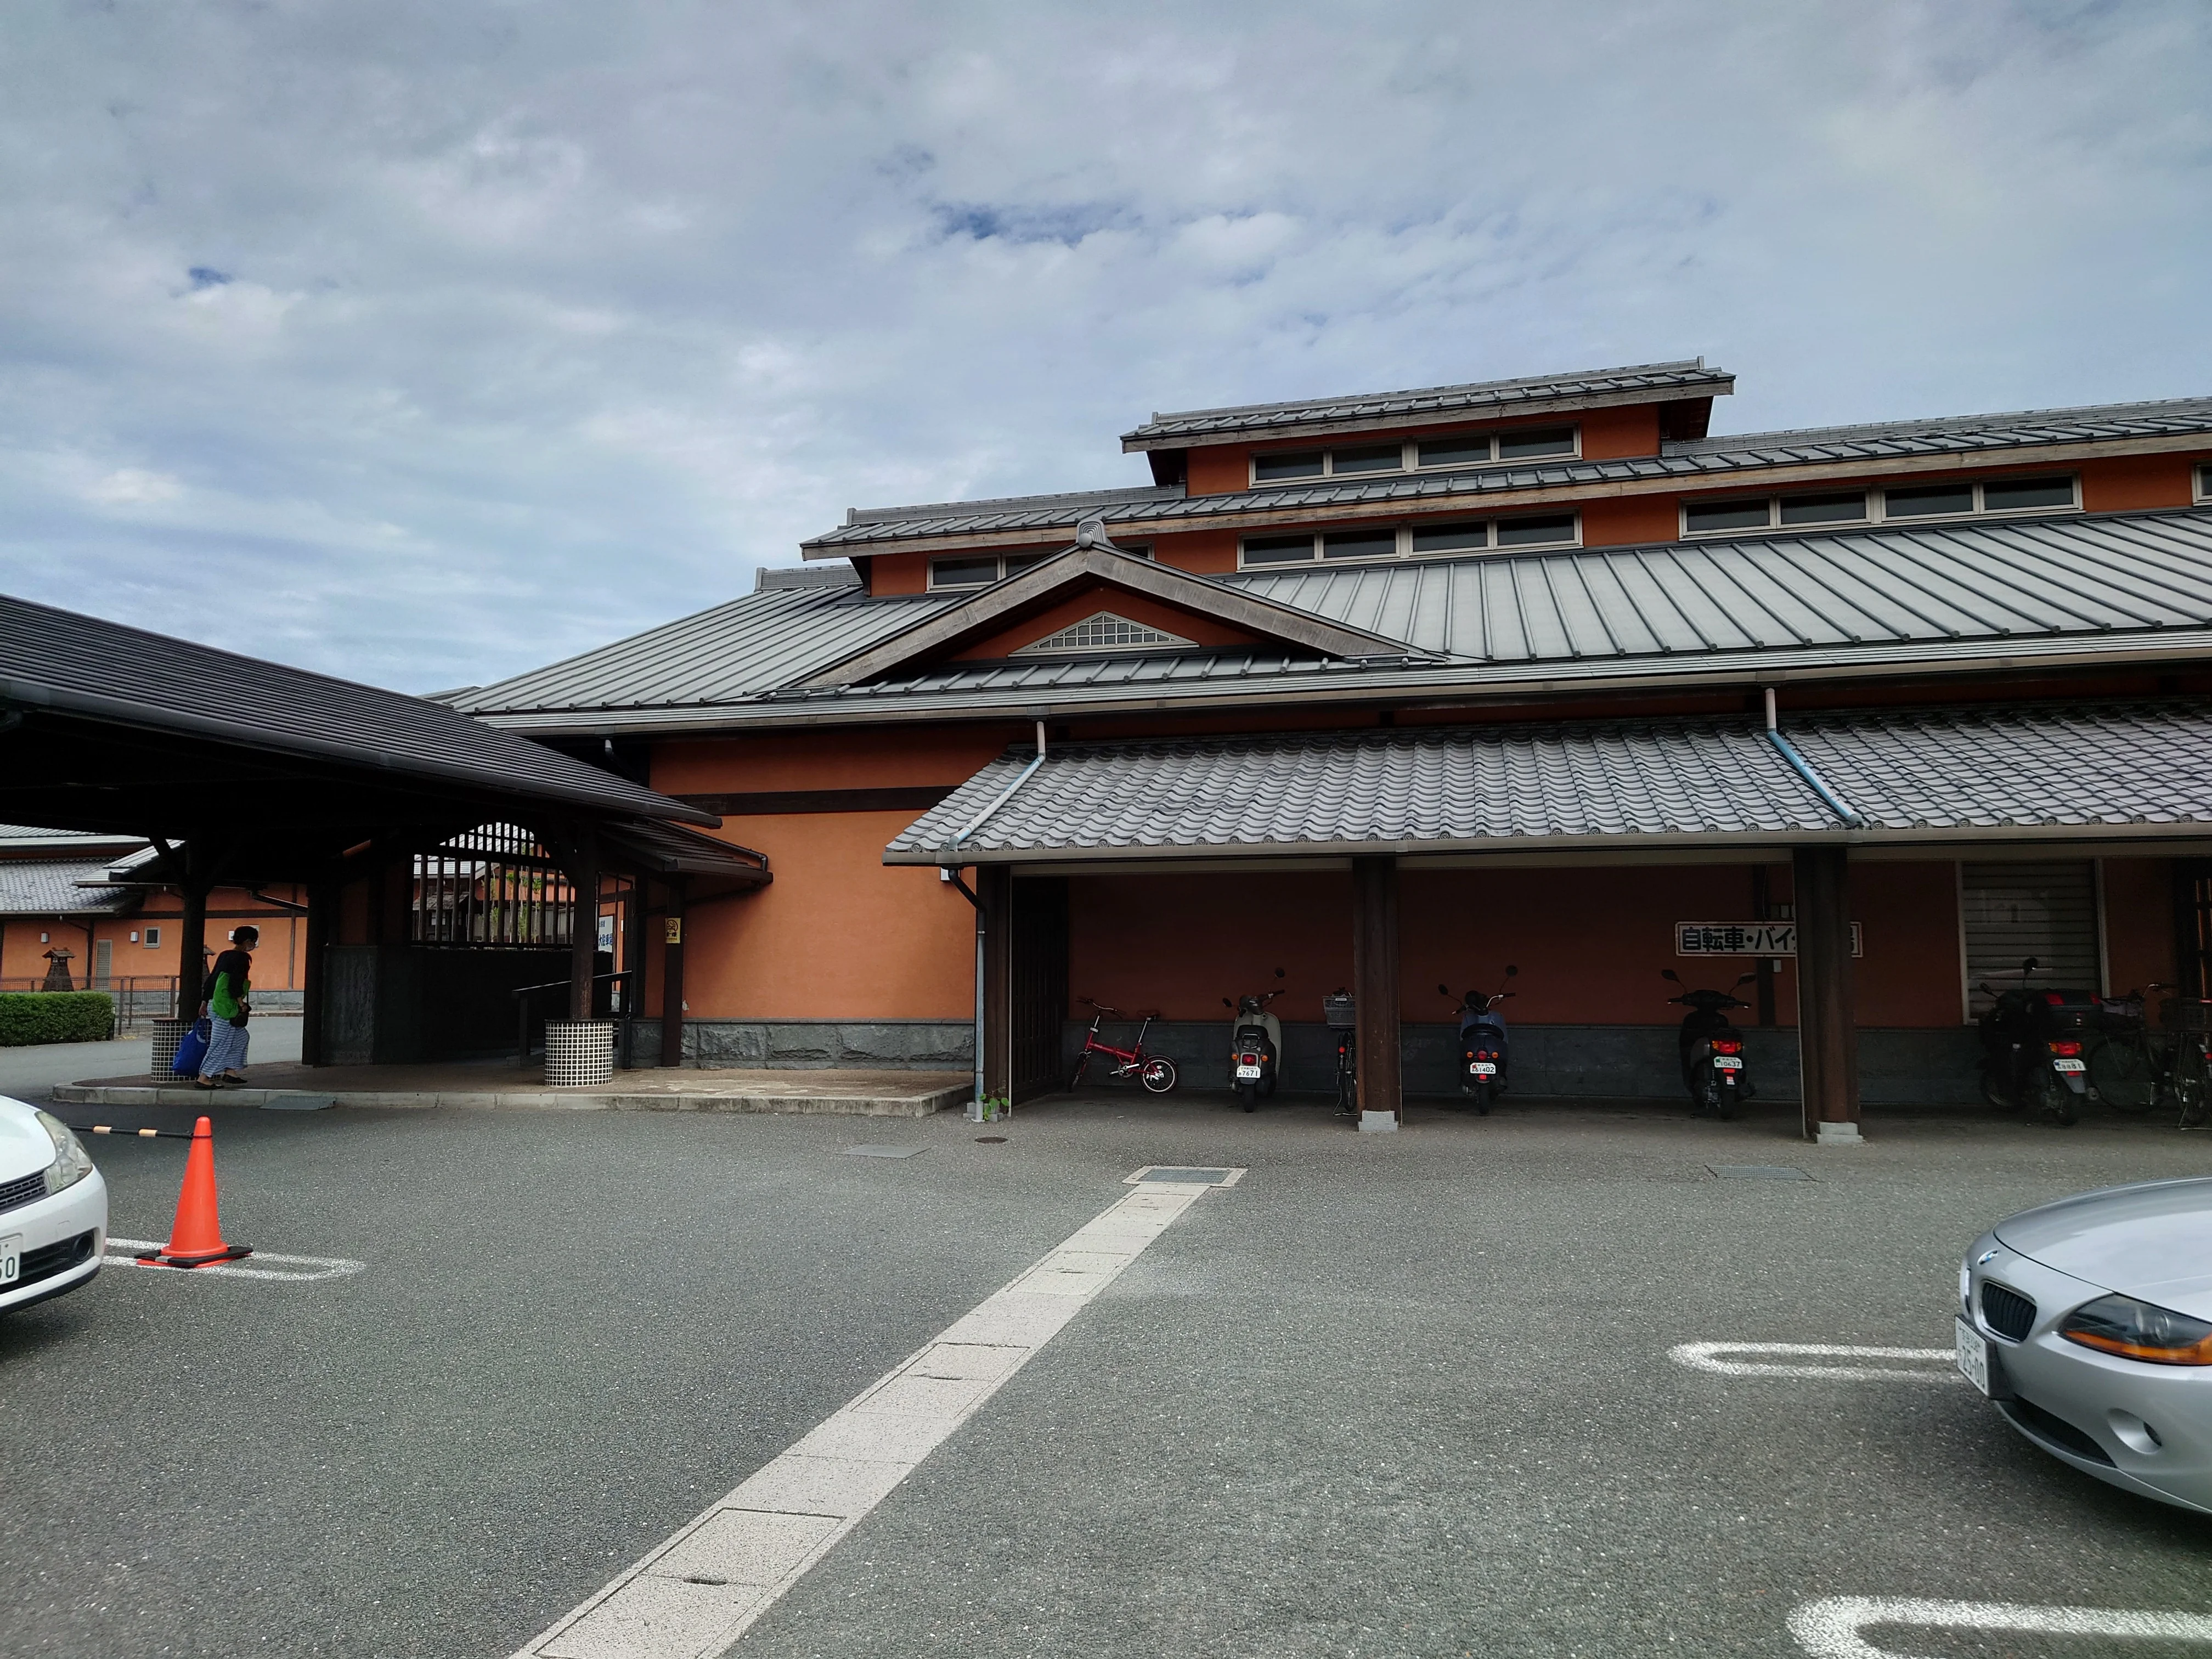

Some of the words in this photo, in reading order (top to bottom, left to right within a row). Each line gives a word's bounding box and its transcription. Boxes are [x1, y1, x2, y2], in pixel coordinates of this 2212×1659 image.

[1682, 926, 1796, 951] 自転車・バイ
[0, 1256, 15, 1279] 0
